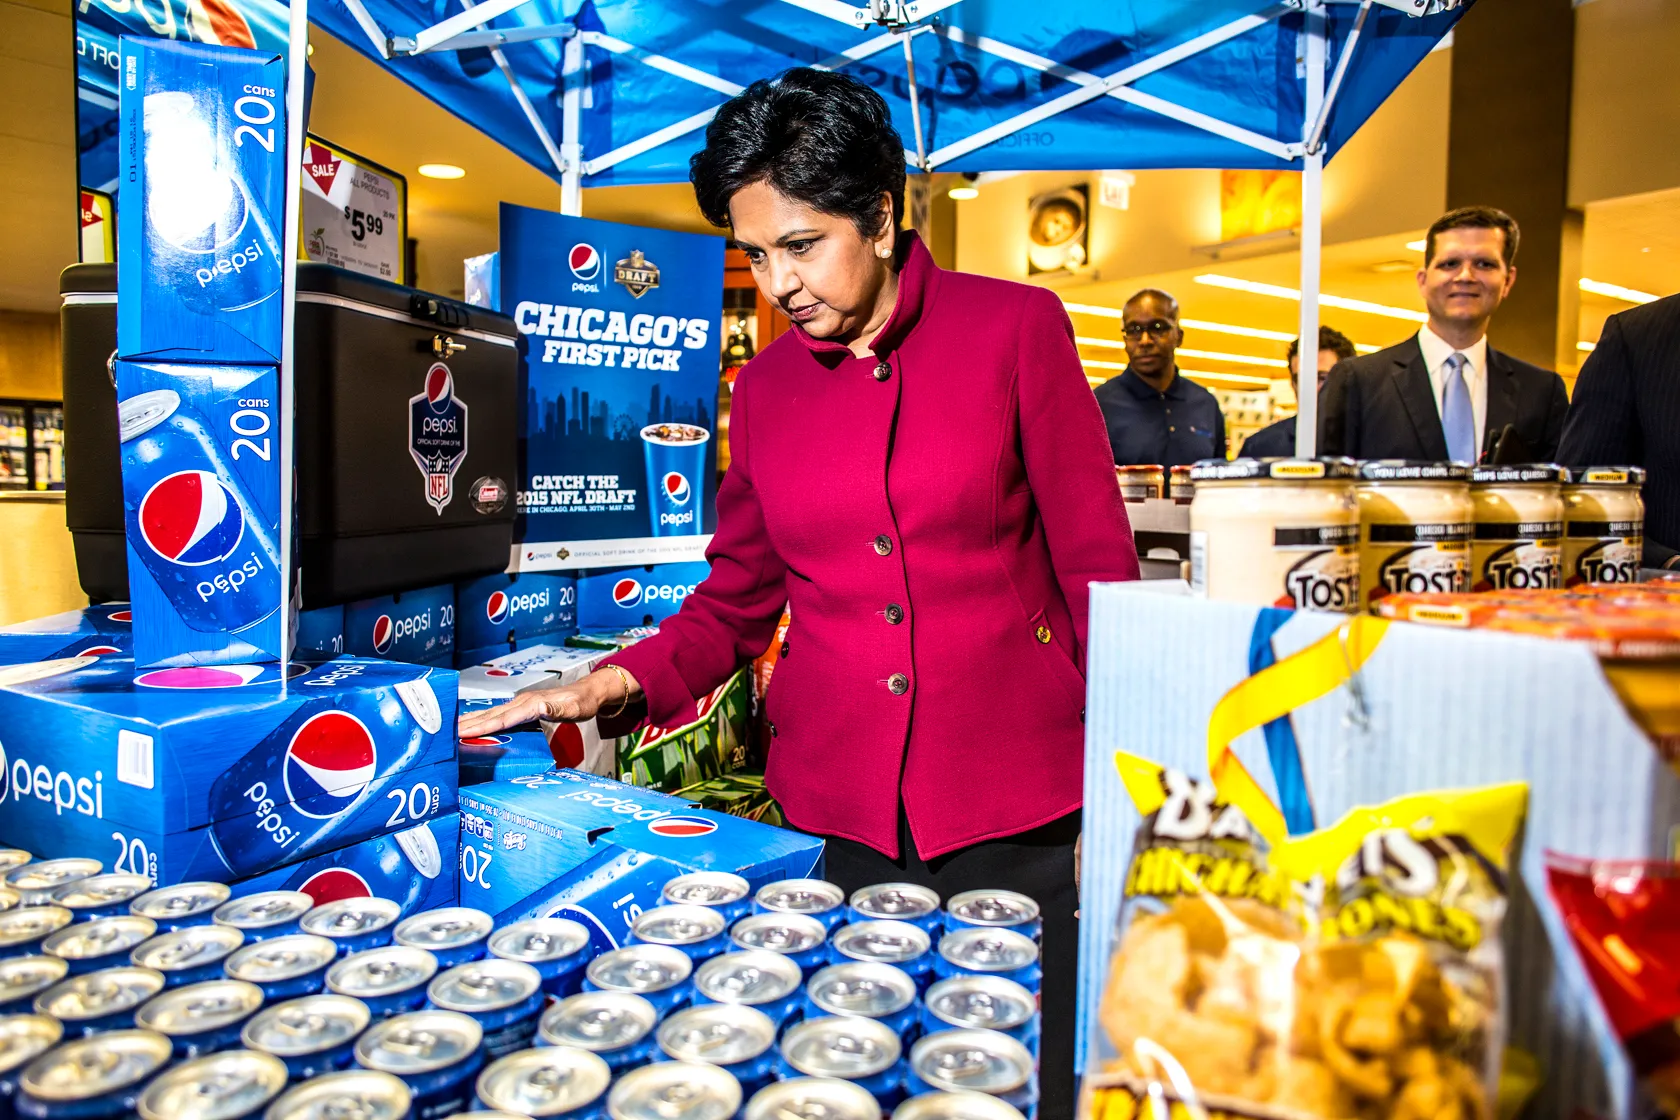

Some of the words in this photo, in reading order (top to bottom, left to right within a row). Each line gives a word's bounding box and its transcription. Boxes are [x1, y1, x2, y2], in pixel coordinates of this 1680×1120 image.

[243, 83, 276, 98] cans
[234, 95, 275, 153] 20
[312, 164, 335, 177] SALE
[350, 177, 360, 189] ALL
[360, 181, 390, 200] PRODUCTS
[196, 239, 264, 288] pepsi
[572, 282, 598, 294] pepsi
[618, 270, 656, 283] DRAFT
[515, 301, 710, 350] CHICAGO'S
[542, 340, 620, 368] FIRST
[621, 346, 682, 372] PICK
[238, 397, 270, 409] cans
[230, 409, 271, 462] 20
[423, 416, 456, 437] pepsi
[430, 474, 448, 499] NFL
[532, 475, 585, 490] CATCH
[587, 475, 619, 489] THE
[516, 492, 549, 506] 2015
[551, 491, 583, 505] NFL
[585, 489, 636, 504] DRAFT
[661, 510, 693, 526] pepsi
[196, 551, 264, 602] pepsi
[510, 588, 550, 617] pepsi
[559, 586, 574, 606] 20
[644, 580, 703, 603] peps
[395, 607, 431, 644] pepsi
[439, 604, 454, 628] 20
[303, 664, 367, 686] pepsi
[732, 745, 746, 762] 20
[12, 757, 103, 819] pepsi
[510, 776, 563, 789] 20
[243, 781, 301, 849] pepsi
[385, 781, 432, 828] 20
[430, 786, 440, 815] cans
[557, 790, 672, 821] pepsi
[112, 831, 149, 876] 20
[463, 845, 492, 890] 20
